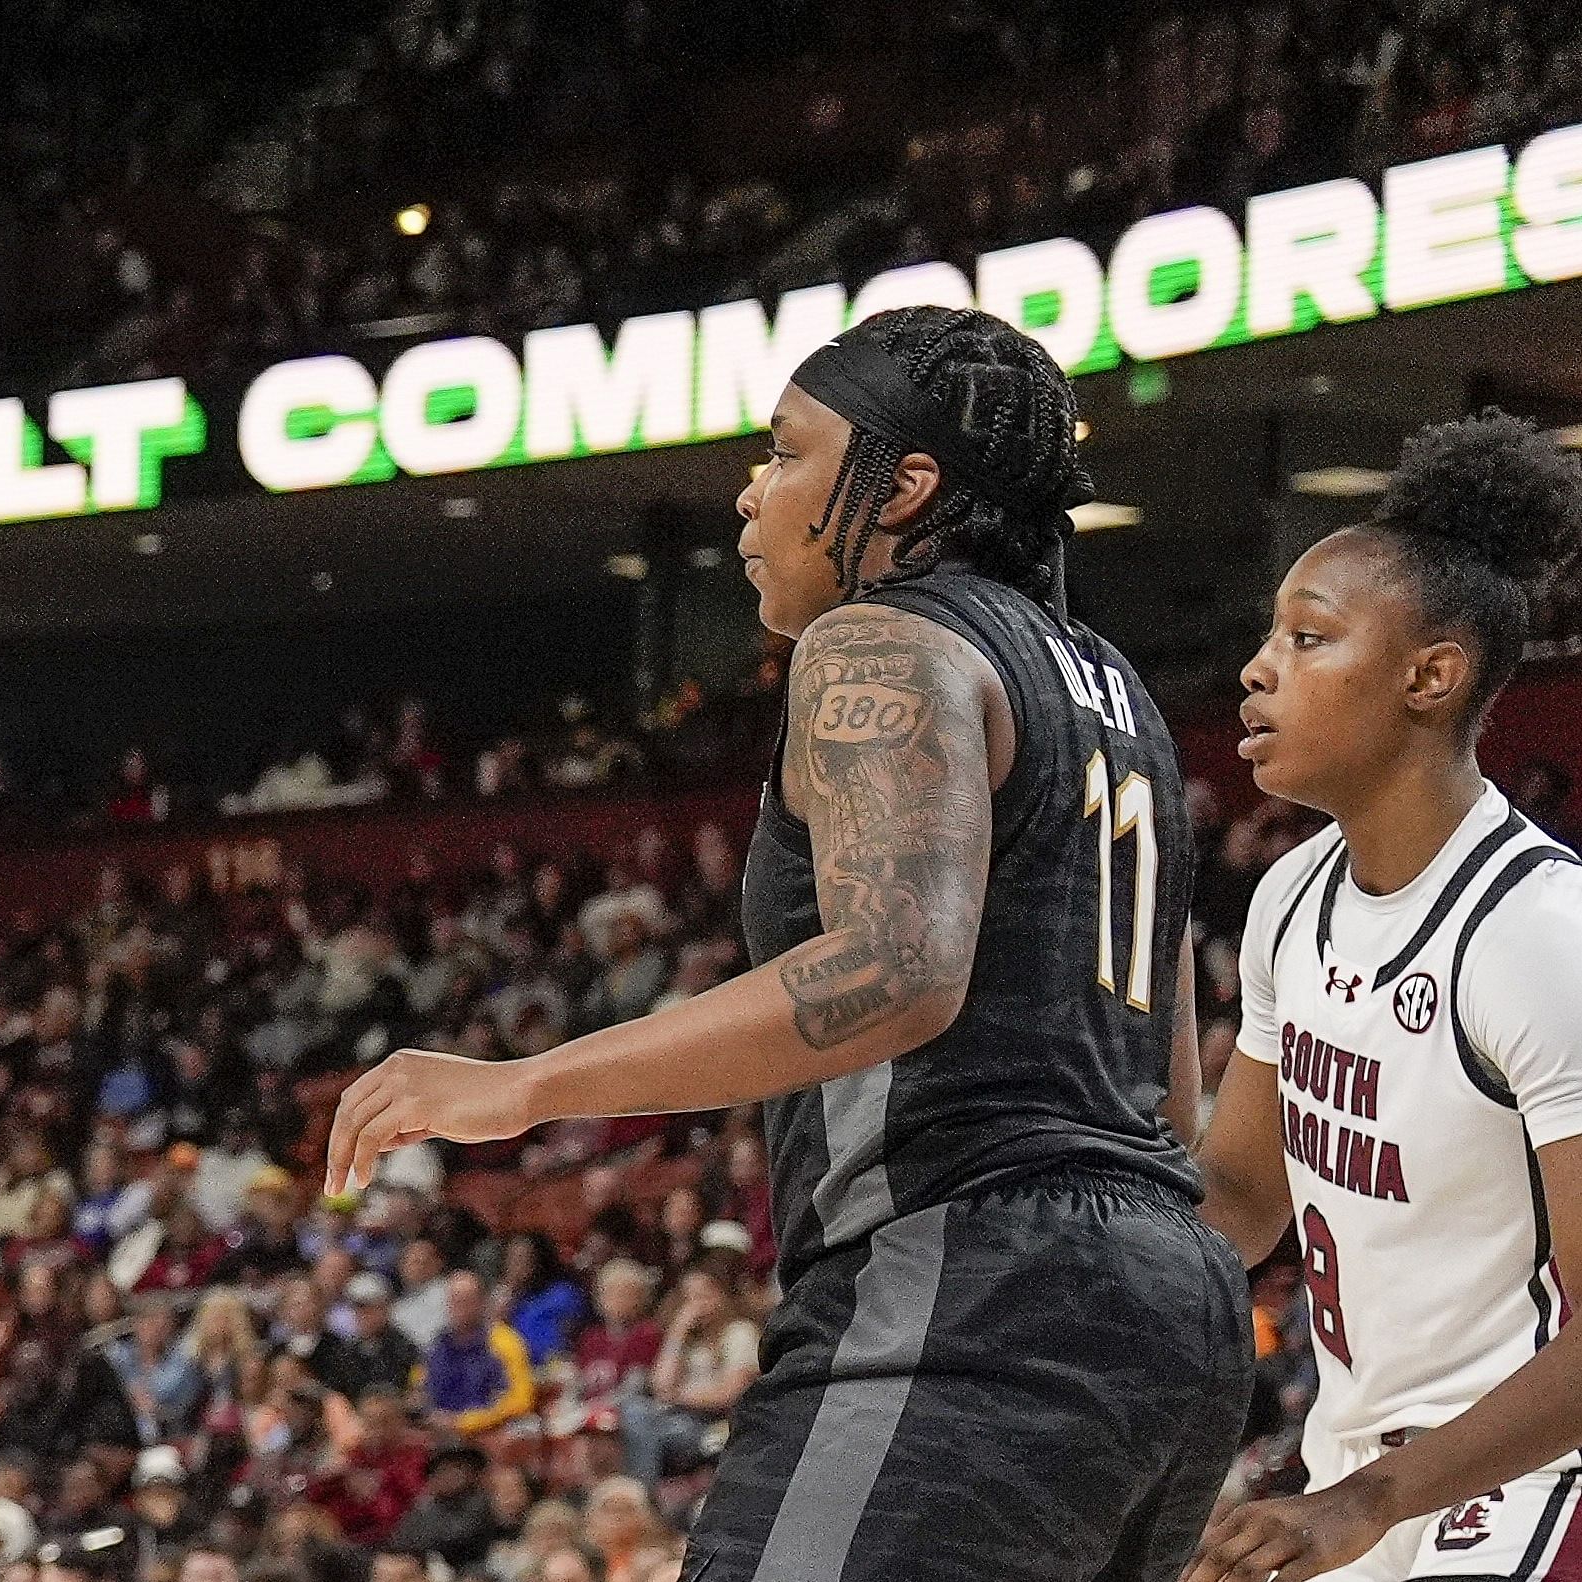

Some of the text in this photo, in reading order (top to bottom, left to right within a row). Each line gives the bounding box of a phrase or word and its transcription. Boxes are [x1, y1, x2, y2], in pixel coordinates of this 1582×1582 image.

[823, 695, 906, 732] 380
[1084, 748, 1158, 1014] 11
[1395, 974, 1437, 1032] SEC
[1280, 1022, 1381, 1121] SOUTH
[1280, 1091, 1410, 1203] ROLINA
